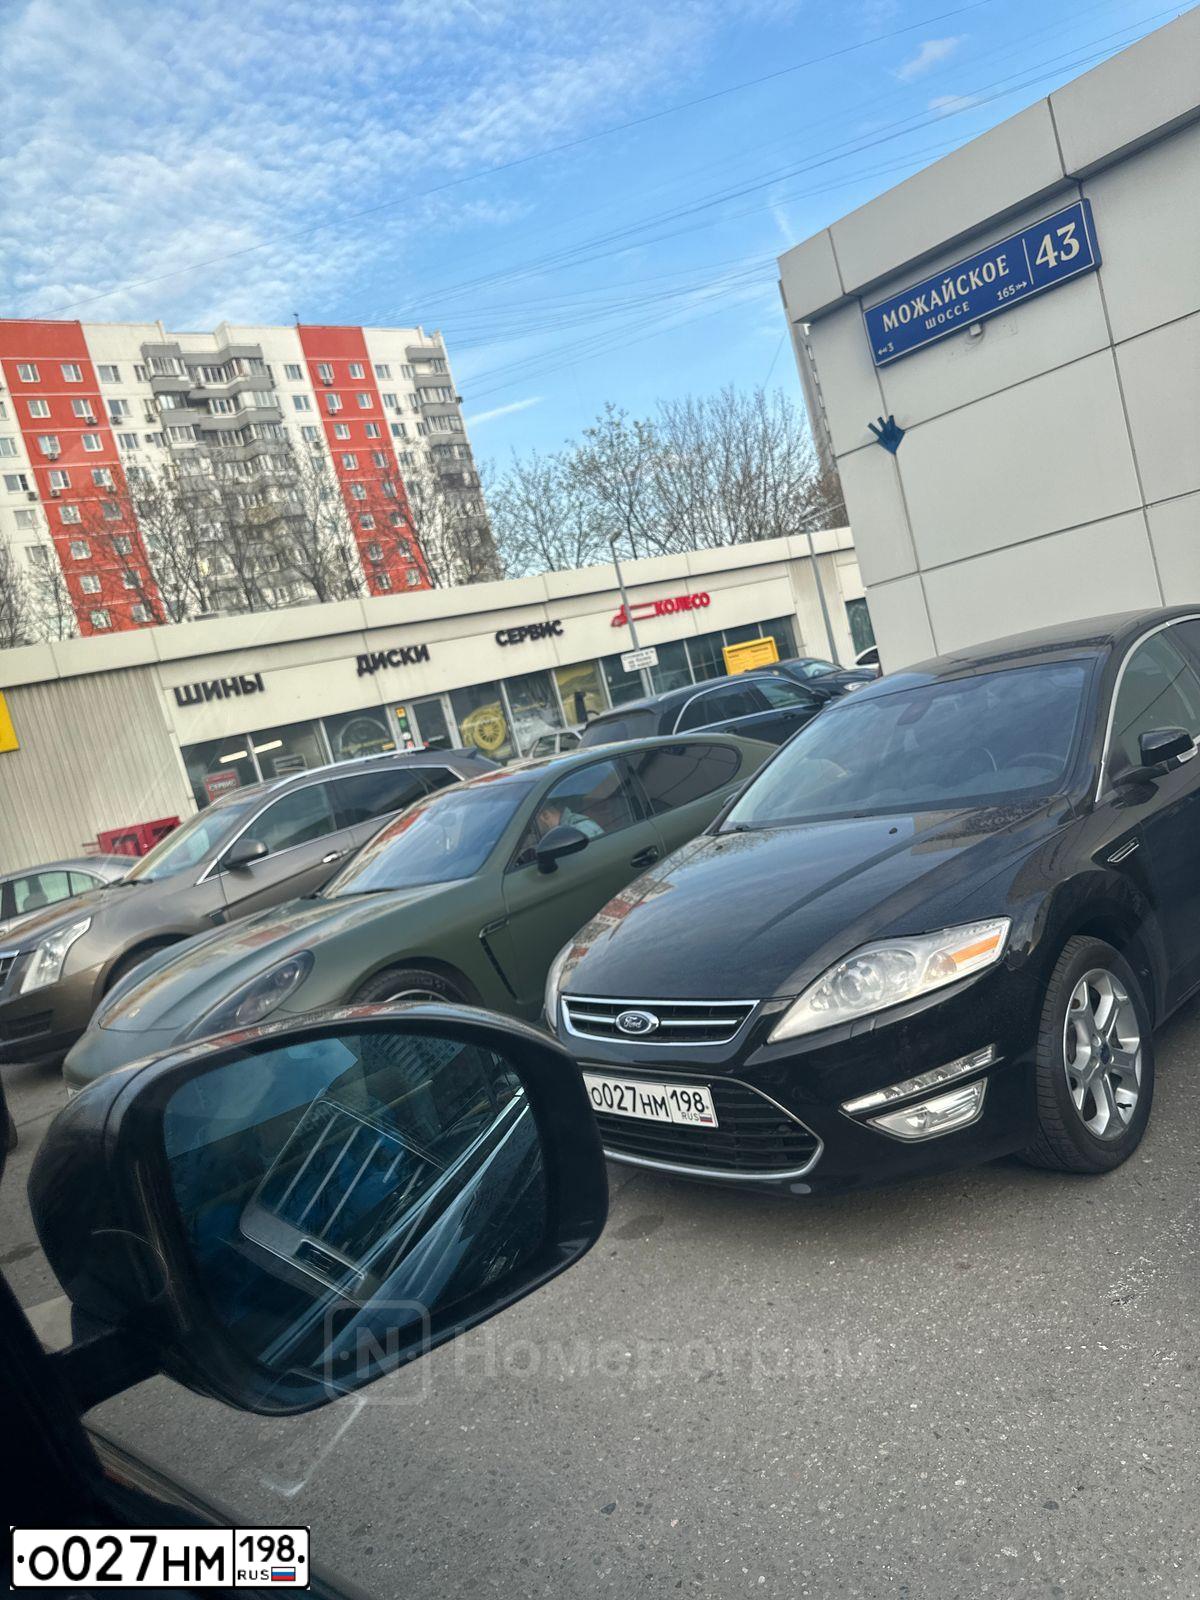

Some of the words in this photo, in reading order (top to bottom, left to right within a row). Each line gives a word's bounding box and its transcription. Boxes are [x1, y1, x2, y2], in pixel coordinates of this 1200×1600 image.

[1034, 221, 1081, 269] 43
[882, 254, 1010, 333] МОЖАЙСКОЕ
[996, 284, 1016, 301] 165
[925, 301, 971, 330] ШОССЕ
[654, 592, 711, 616] КОЛЕСО
[495, 620, 564, 647] СЕРВИС
[356, 644, 431, 677] ДИСКИ
[174, 672, 265, 707] ШИНЫ
[622, 1015, 643, 1029] Ford
[590, 1083, 670, 1118] О027НМ
[670, 1089, 705, 1113] 198
[681, 1111, 699, 1121] RUS
